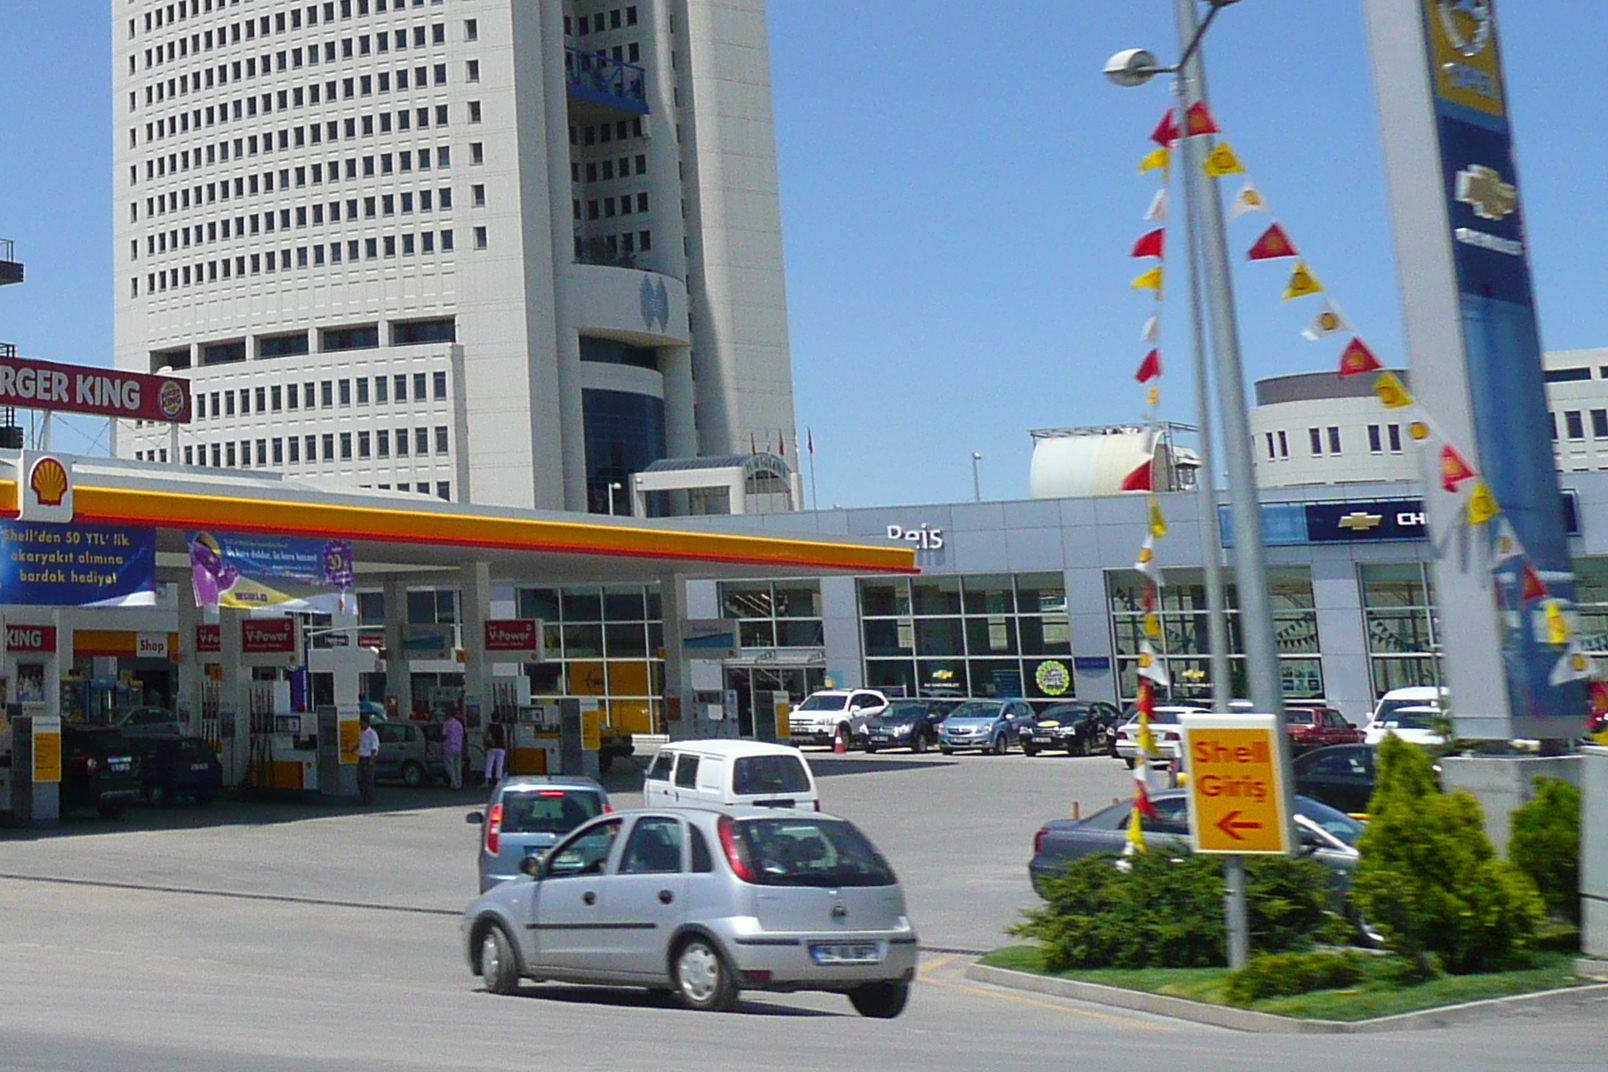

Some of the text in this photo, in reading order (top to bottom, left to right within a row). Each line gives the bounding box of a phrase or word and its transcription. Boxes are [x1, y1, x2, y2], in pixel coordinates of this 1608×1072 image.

[75, 373, 140, 410] KING
[3, 530, 61, 543] Shell'den
[66, 531, 80, 544] 50
[114, 533, 130, 546] lik
[11, 549, 123, 565] akaryakıt alımına
[19, 569, 65, 583] bardak
[235, 592, 268, 603] WORLD
[6, 630, 42, 647] KING
[246, 631, 288, 642] V-Power
[489, 630, 530, 641] V-Power
[139, 639, 164, 654] Shop
[1194, 740, 1270, 764] Shell
